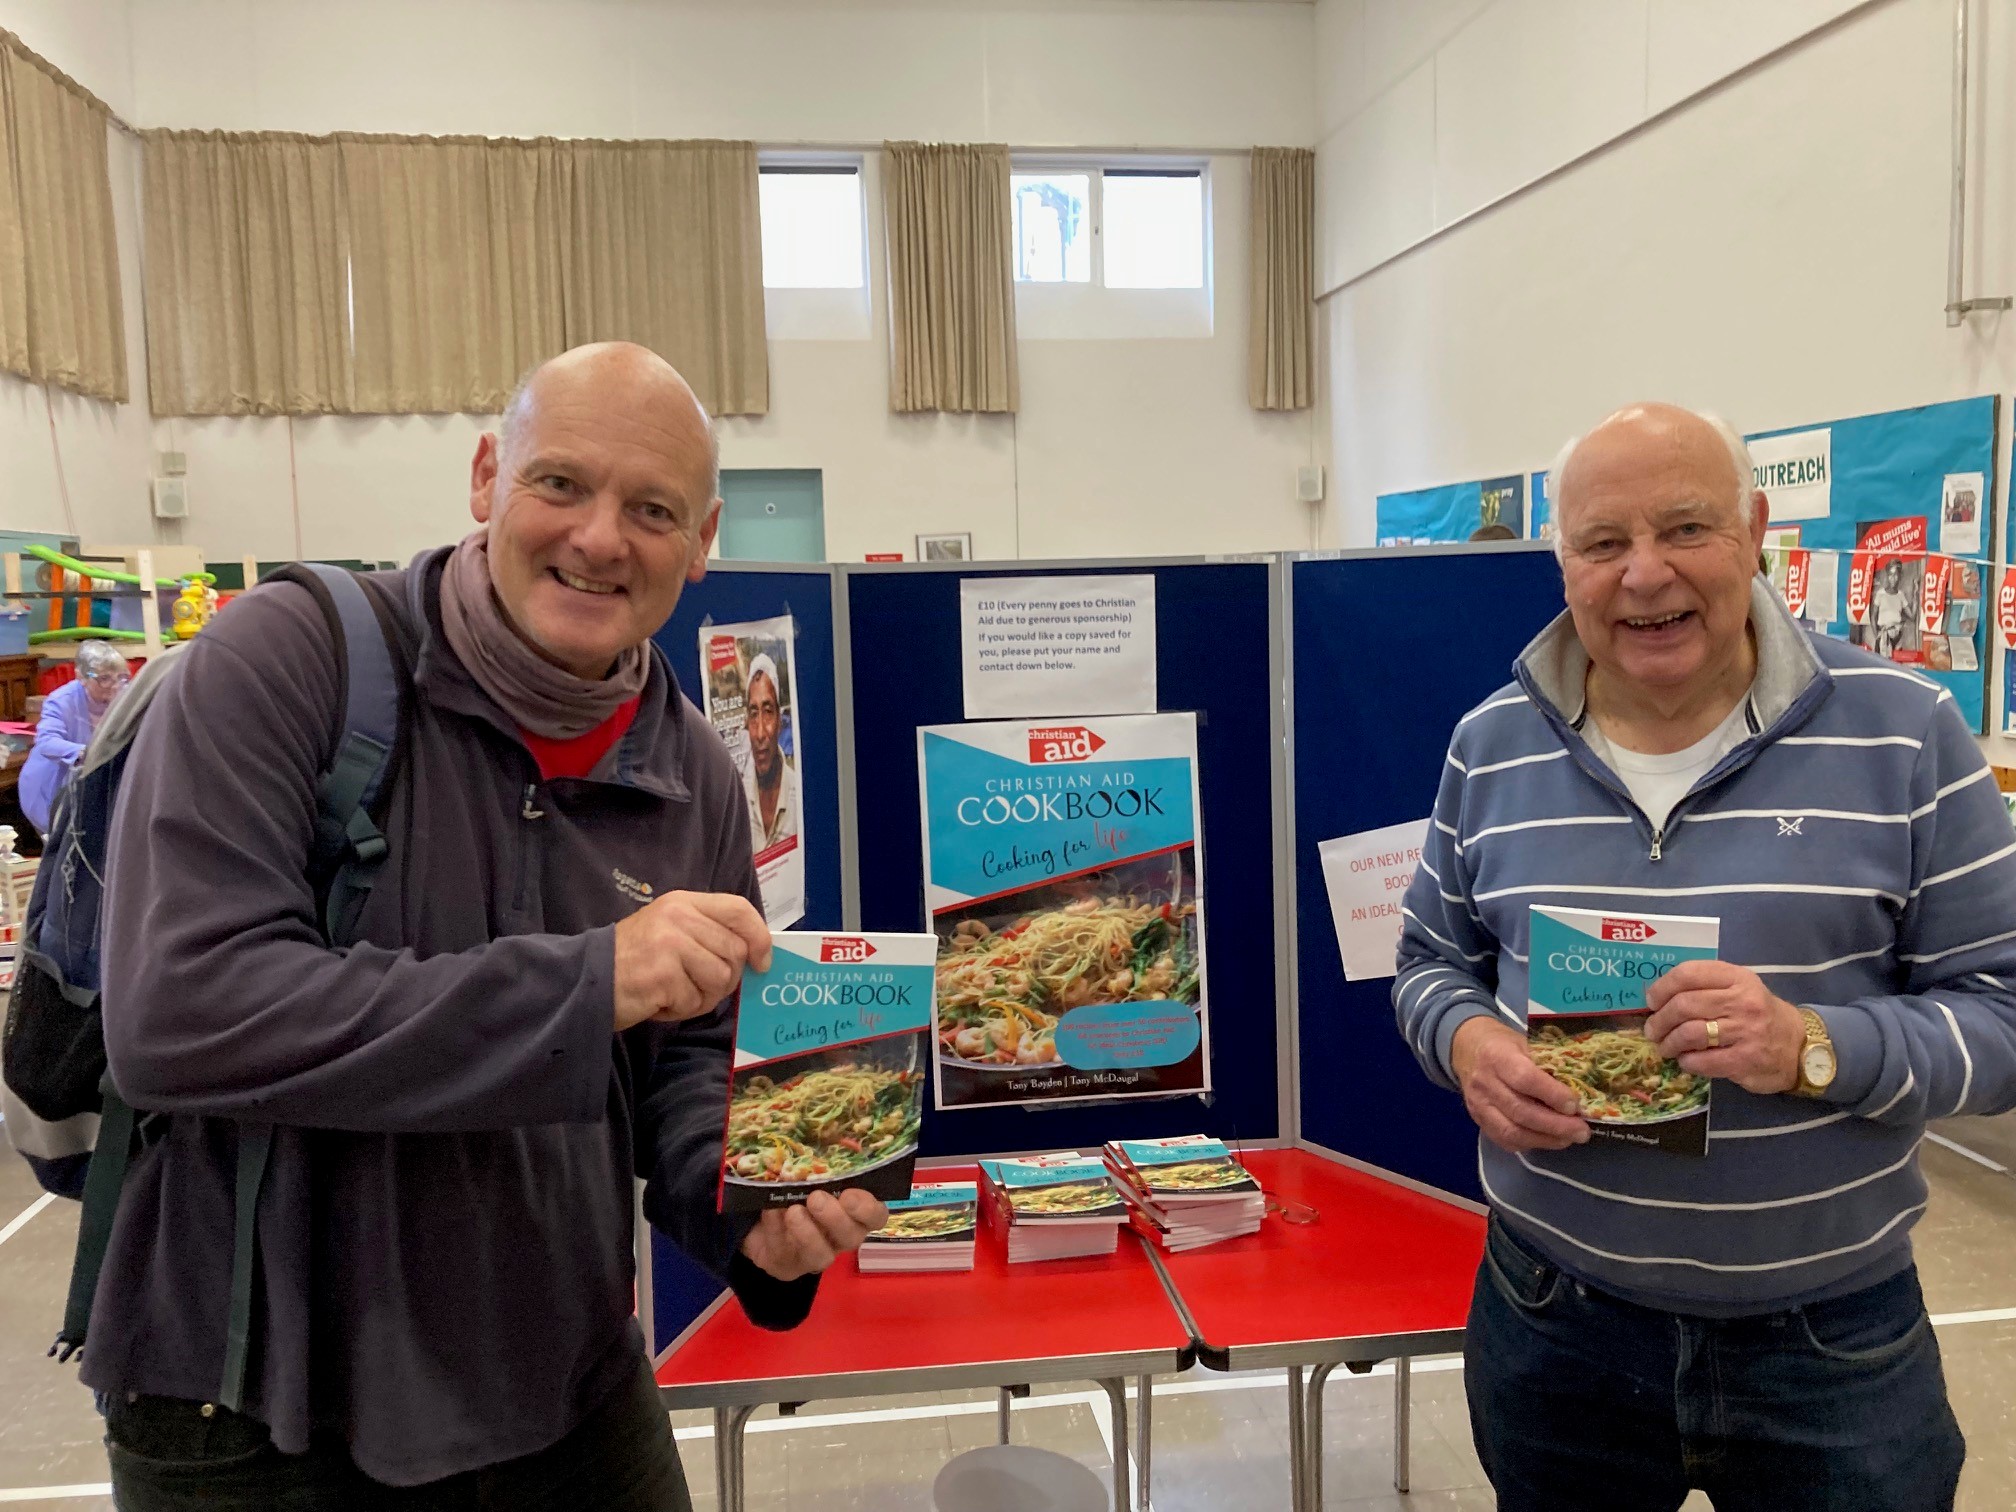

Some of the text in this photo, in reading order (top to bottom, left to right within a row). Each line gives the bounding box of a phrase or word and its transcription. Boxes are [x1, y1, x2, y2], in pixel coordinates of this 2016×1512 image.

[1883, 520, 1911, 542] mums
[1789, 565, 1802, 604] aid
[1850, 568, 1865, 610] aid
[1925, 572, 1939, 617] aid
[978, 599, 1136, 611] £10 (Every penny goes to Christian
[978, 613, 1132, 626] Aid due to generous sponsorship)
[979, 630, 1131, 643] If you would like a copy saved for
[979, 645, 1121, 658] you, please put your name and
[980, 661, 1075, 671] contact down below.
[728, 695, 743, 709] are
[1029, 730, 1076, 739] christian
[1044, 731, 1093, 761] aid
[986, 773, 1135, 792] CHRISTIAN AID
[957, 788, 1164, 826] COOKBOOK
[982, 822, 1127, 878] Cooking for life
[1350, 857, 1375, 873] OUR
[1377, 852, 1403, 868] NEW
[1351, 902, 1401, 921] AN IDEAL
[1612, 923, 1647, 941] aid
[831, 941, 868, 962] aid
[1569, 945, 1675, 962] CHRISTIAN AID
[784, 972, 894, 982] CHRISTIAN AID
[762, 984, 912, 1006] COOKBOOK
[1562, 987, 1613, 1009] Cooking
[774, 1021, 828, 1045] Cooking
[835, 1020, 854, 1039] for
[1008, 1073, 1138, 1091] Tony Boyden Tony McDougal
